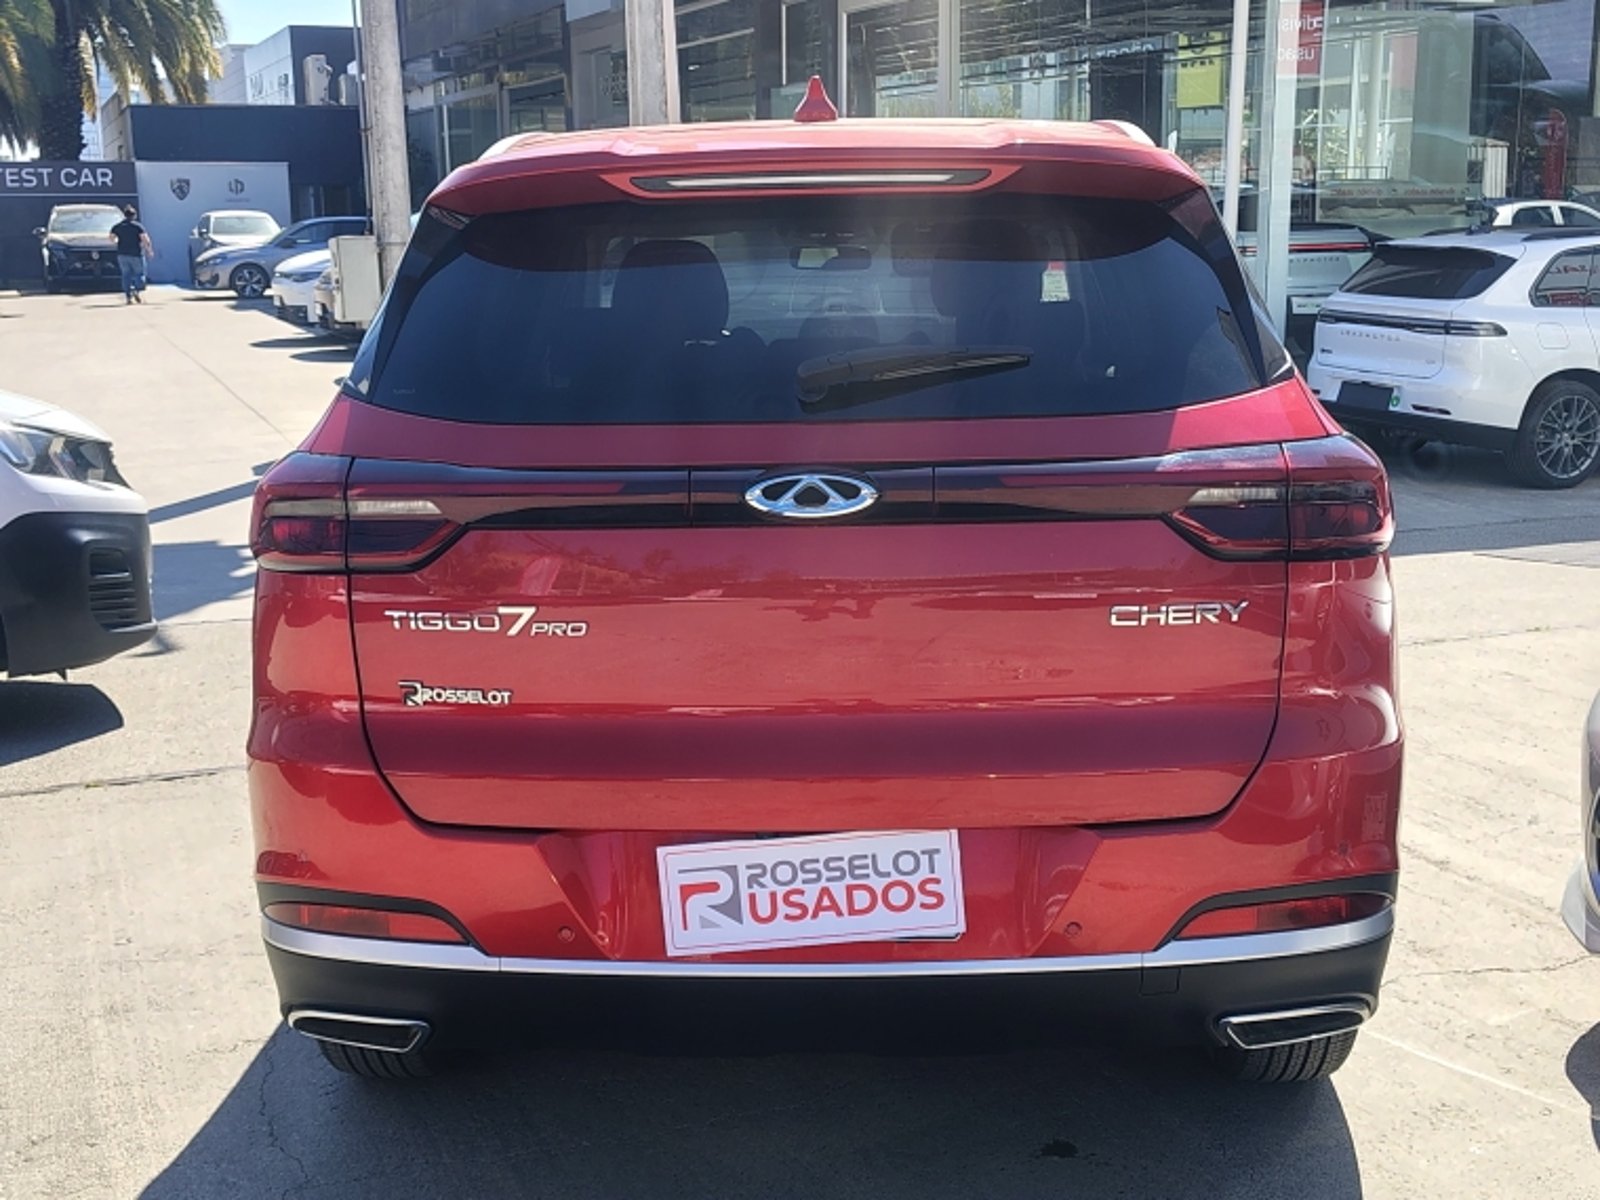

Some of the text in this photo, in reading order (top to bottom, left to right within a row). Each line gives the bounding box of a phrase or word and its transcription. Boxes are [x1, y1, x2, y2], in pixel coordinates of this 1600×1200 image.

[0, 167, 113, 188] EST CAR
[1110, 601, 1249, 627] CHERY
[745, 848, 942, 890] ROSSELOT
[747, 876, 946, 925] USADOS
